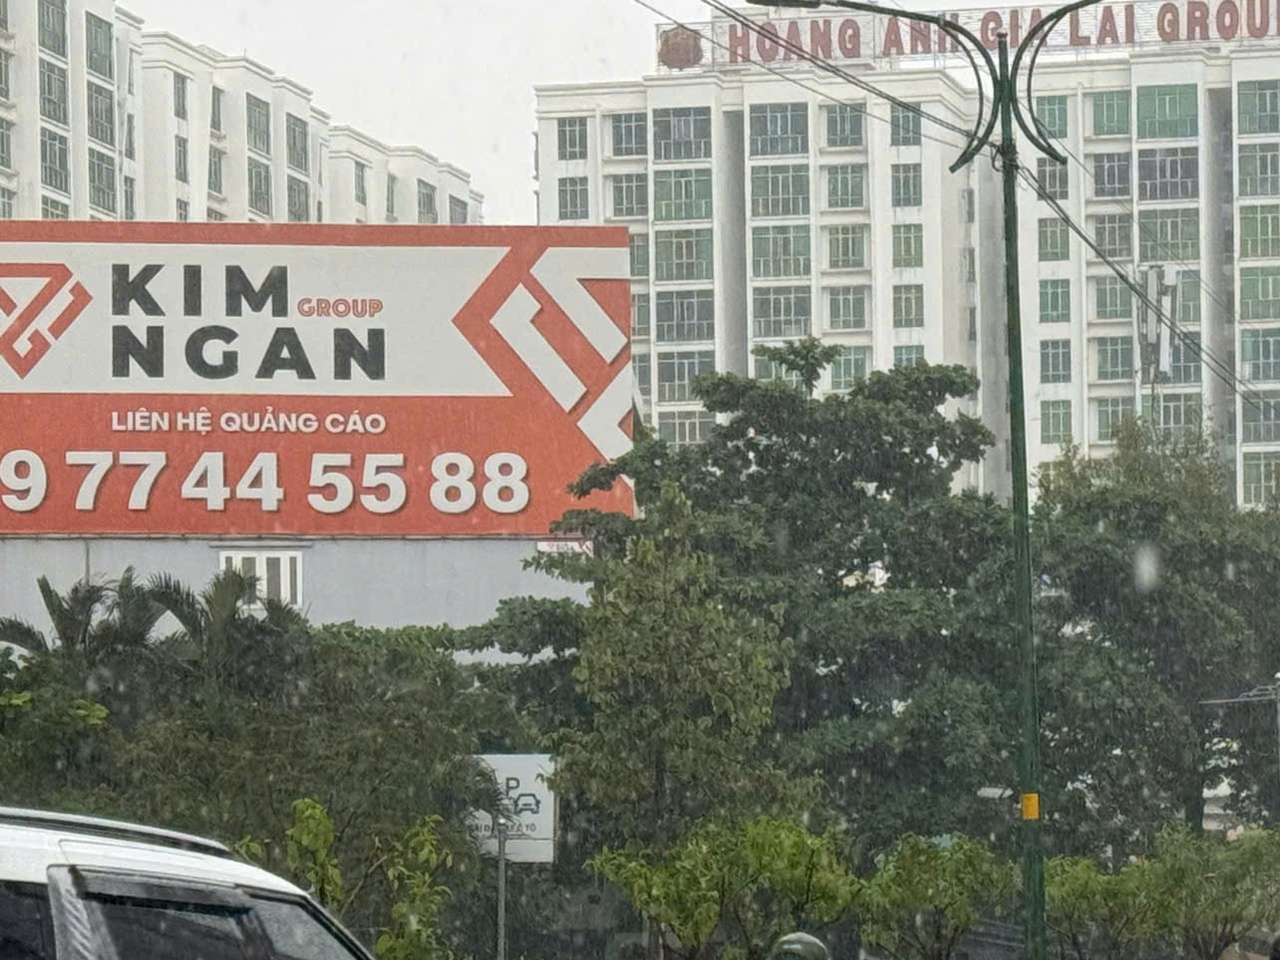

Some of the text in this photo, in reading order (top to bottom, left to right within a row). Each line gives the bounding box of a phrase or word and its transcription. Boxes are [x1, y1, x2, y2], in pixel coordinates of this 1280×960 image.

[729, 20, 861, 63] HOANG
[882, 13, 960, 57] ANH
[981, 9, 1047, 50] GIA
[1069, 4, 1137, 47] LAI
[112, 263, 383, 319] KIM GROUP
[112, 325, 387, 381] NGAN
[112, 408, 387, 435] LIÊN HỆ QUẢNG CÁO
